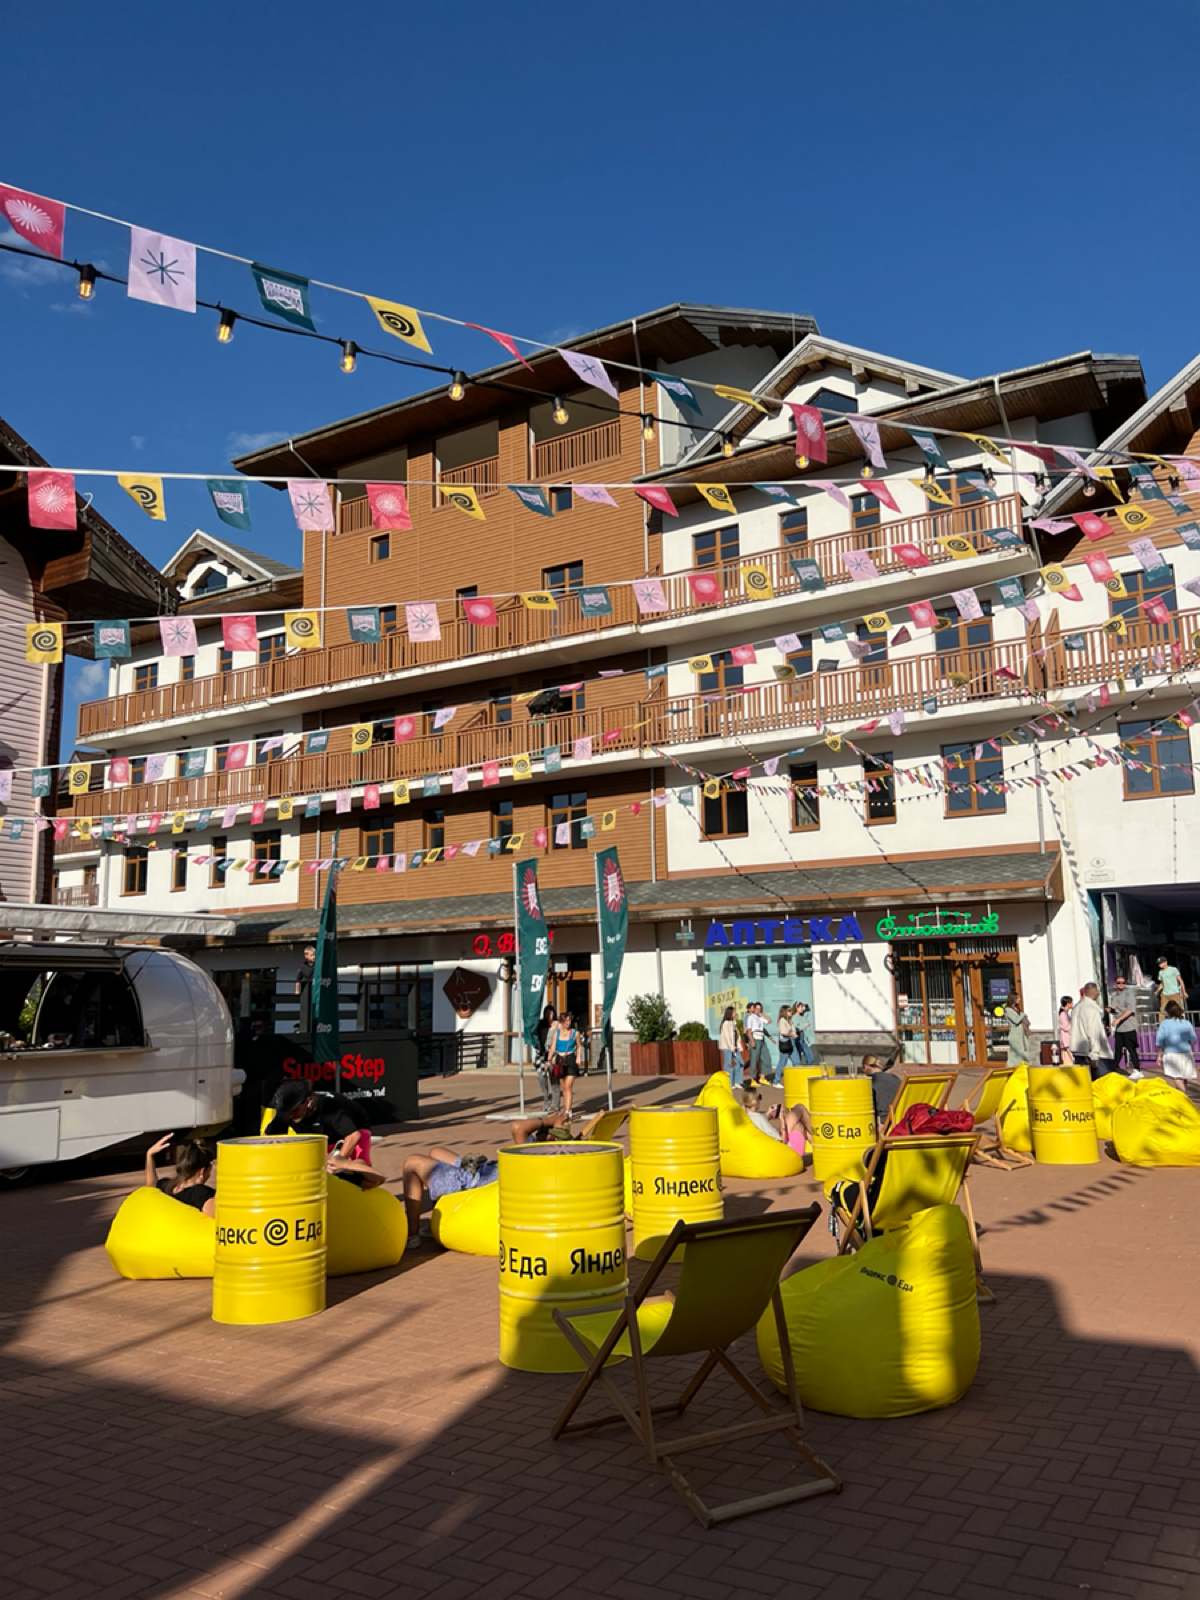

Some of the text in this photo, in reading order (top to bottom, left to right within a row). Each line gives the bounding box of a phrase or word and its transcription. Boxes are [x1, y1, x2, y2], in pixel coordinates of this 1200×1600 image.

[705, 916, 864, 946] АПТЕКА
[721, 949, 872, 979] АПТЕКА
[1034, 1108, 1095, 1123] Еда Яндек
[837, 1124, 861, 1139] Еда
[654, 1176, 714, 1197] Яндекс
[216, 1218, 322, 1246] декс Еда
[508, 1240, 625, 1279] Еда Янде
